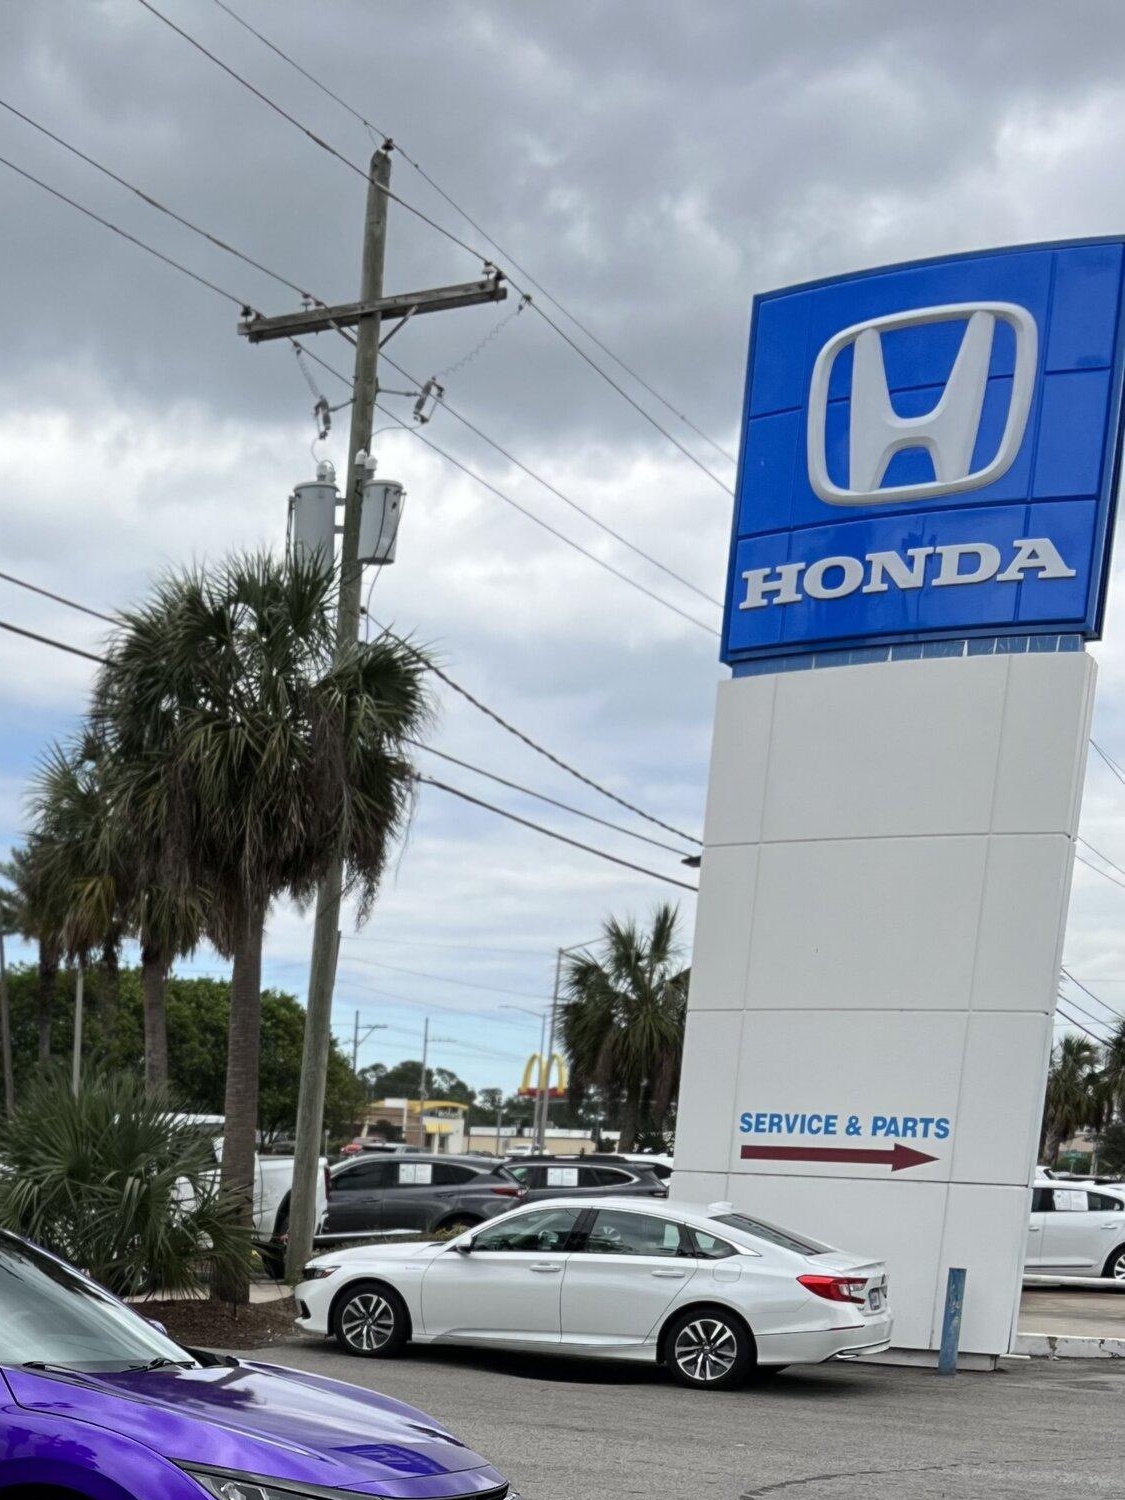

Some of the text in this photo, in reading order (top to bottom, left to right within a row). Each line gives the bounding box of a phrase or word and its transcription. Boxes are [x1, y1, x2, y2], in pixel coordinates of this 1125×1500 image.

[738, 537, 1077, 611] HONDA
[739, 1111, 951, 1140] SERVICE & PARTS
